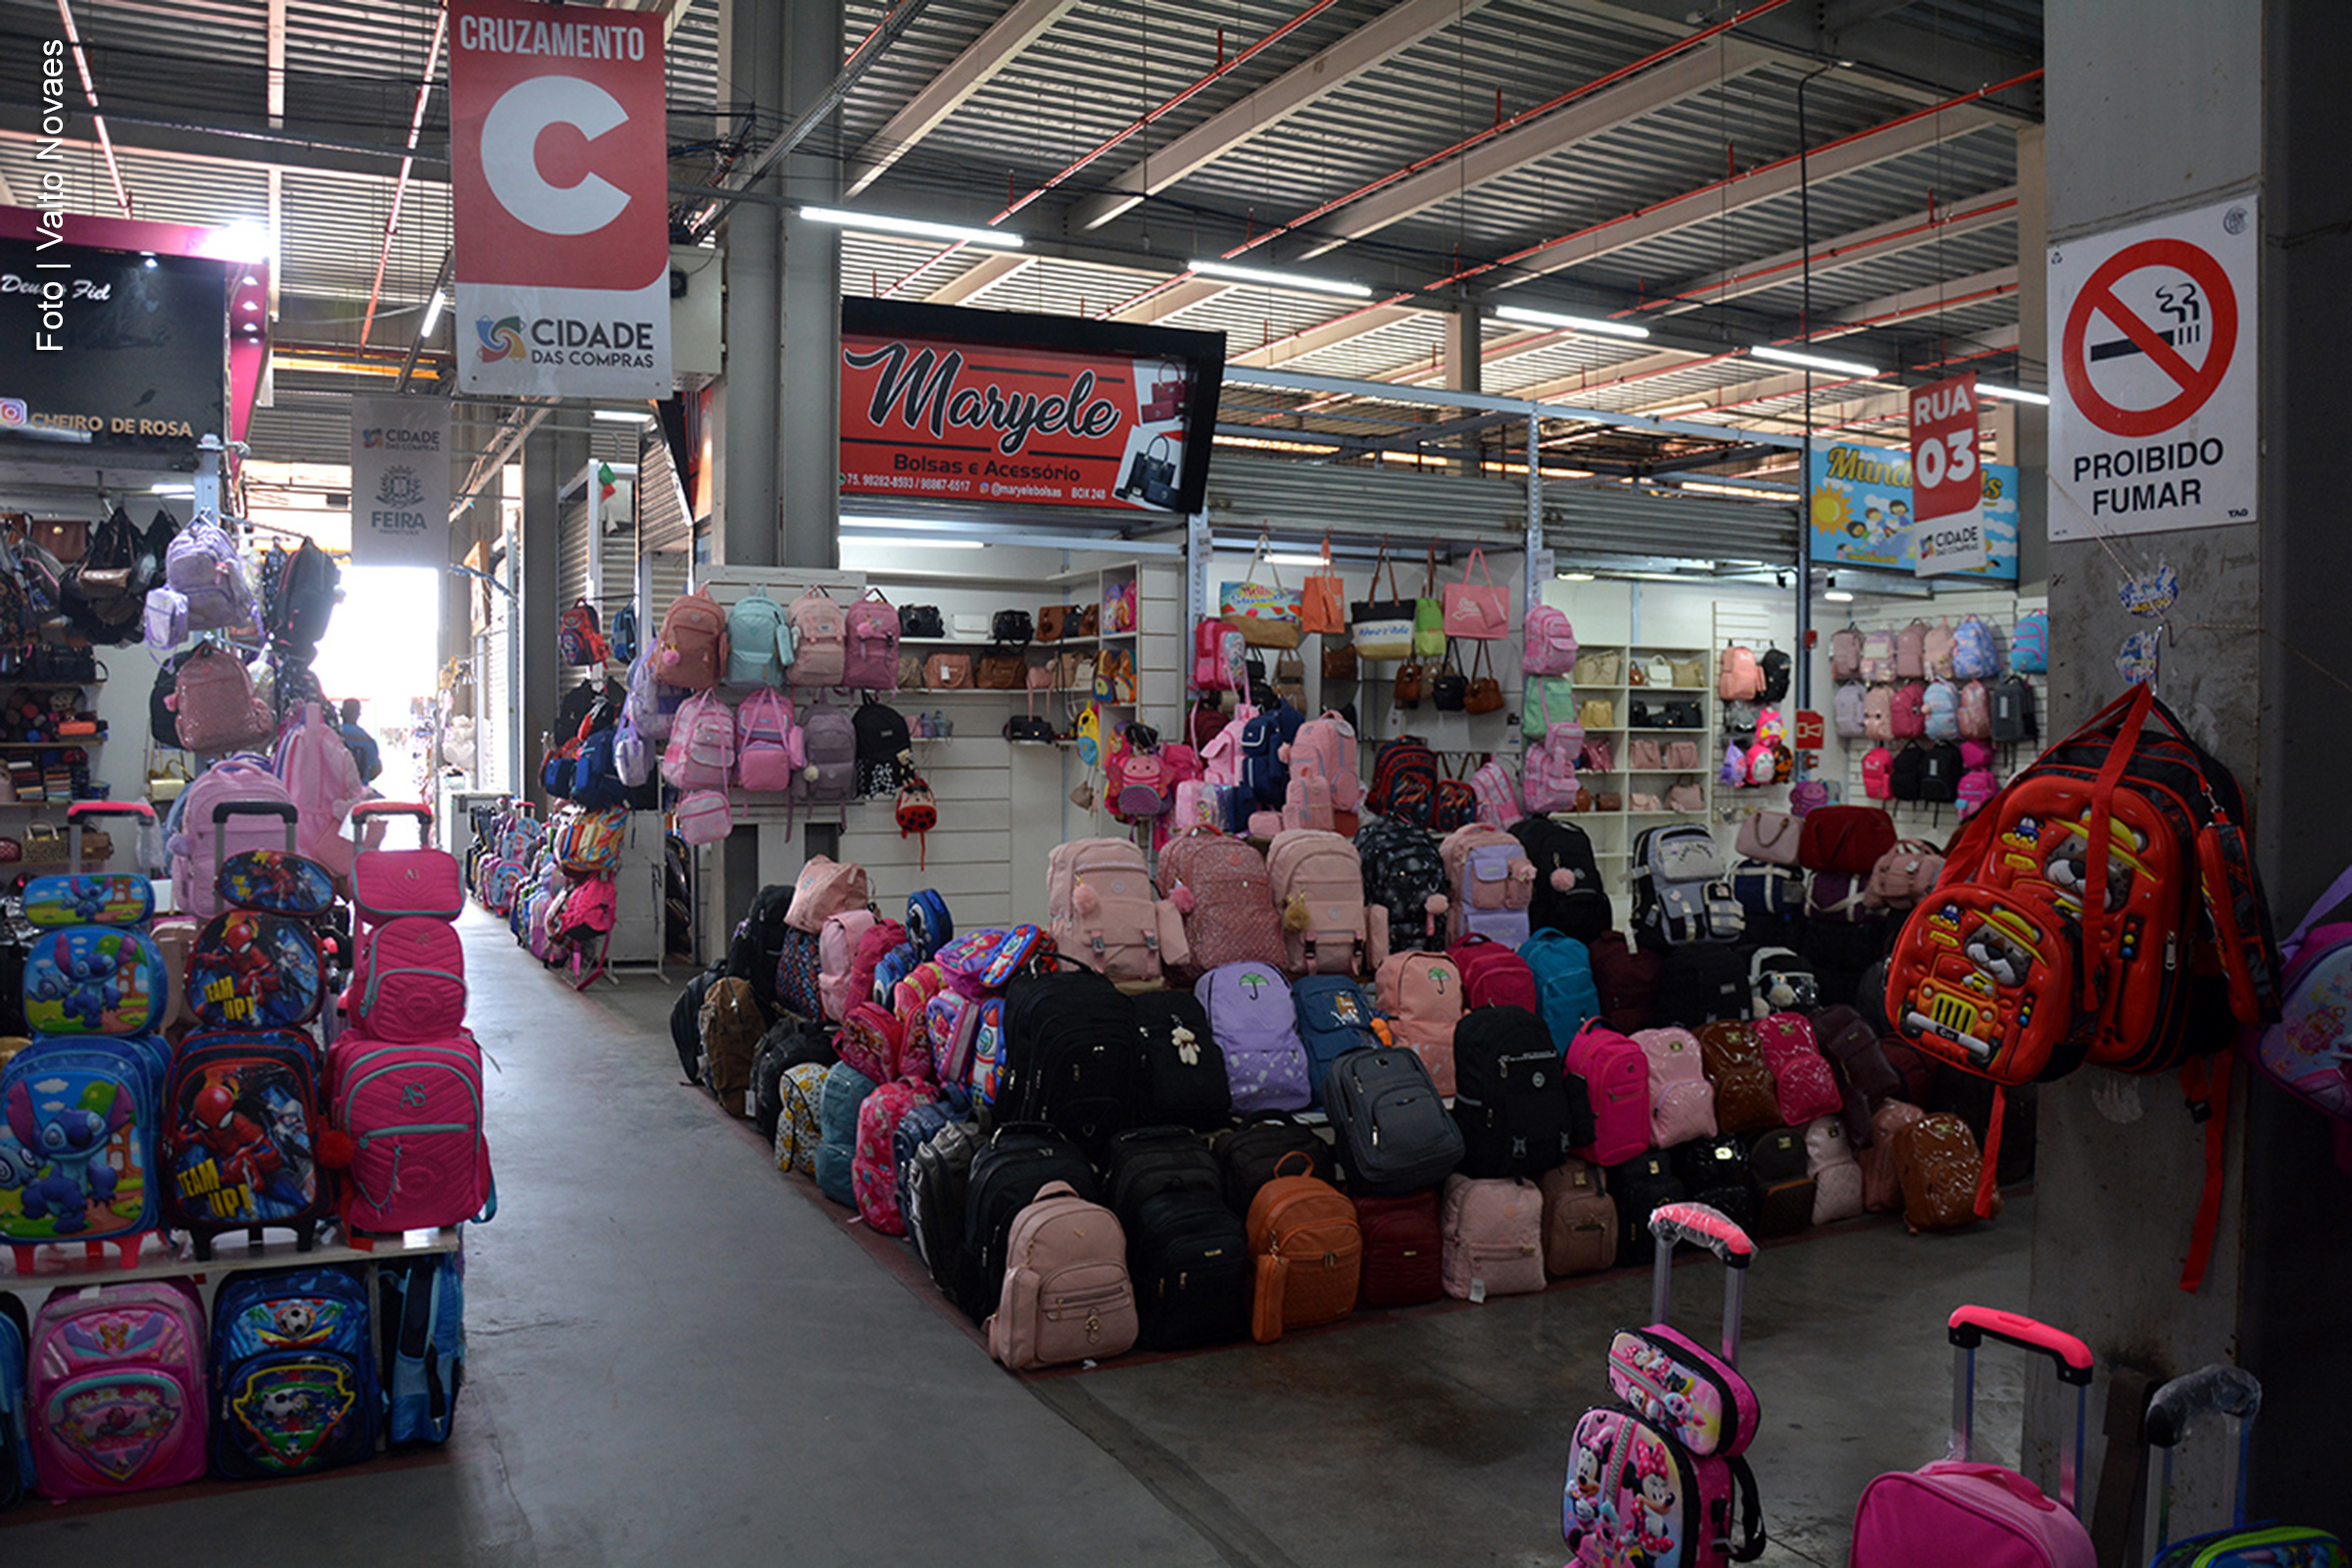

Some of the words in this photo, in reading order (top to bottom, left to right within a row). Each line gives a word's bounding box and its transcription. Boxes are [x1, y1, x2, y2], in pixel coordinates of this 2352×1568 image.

[460, 15, 645, 62] CRUZAMENTO
[480, 75, 632, 235] C
[531, 318, 654, 351] CIDADE
[532, 350, 564, 366] DAS
[569, 351, 655, 368] COMPRAS
[844, 341, 1120, 456] Maryele
[1914, 384, 1972, 427] RUA
[30, 413, 103, 432] CHEIRO
[111, 417, 135, 433] DE
[139, 418, 193, 437] ROSA
[385, 429, 440, 444] CIDADE
[894, 454, 962, 475] Bolsas
[968, 463, 979, 475] e
[984, 461, 1081, 481] Acessório
[1828, 447, 1912, 489] Mund
[1916, 427, 1976, 489] 03
[2075, 438, 2224, 482] PROIBIDO
[991, 482, 1062, 498] @maryelebolsas
[1071, 487, 1090, 499] BOX
[2093, 479, 2201, 516] FUMAR
[371, 512, 427, 529] FEIRA
[1935, 525, 1978, 548] CIDADE
[203, 975, 234, 1003] TEAM
[399, 1082, 426, 1108] AS
[177, 1157, 220, 1198] TEAM
[207, 1183, 251, 1218] UP!
